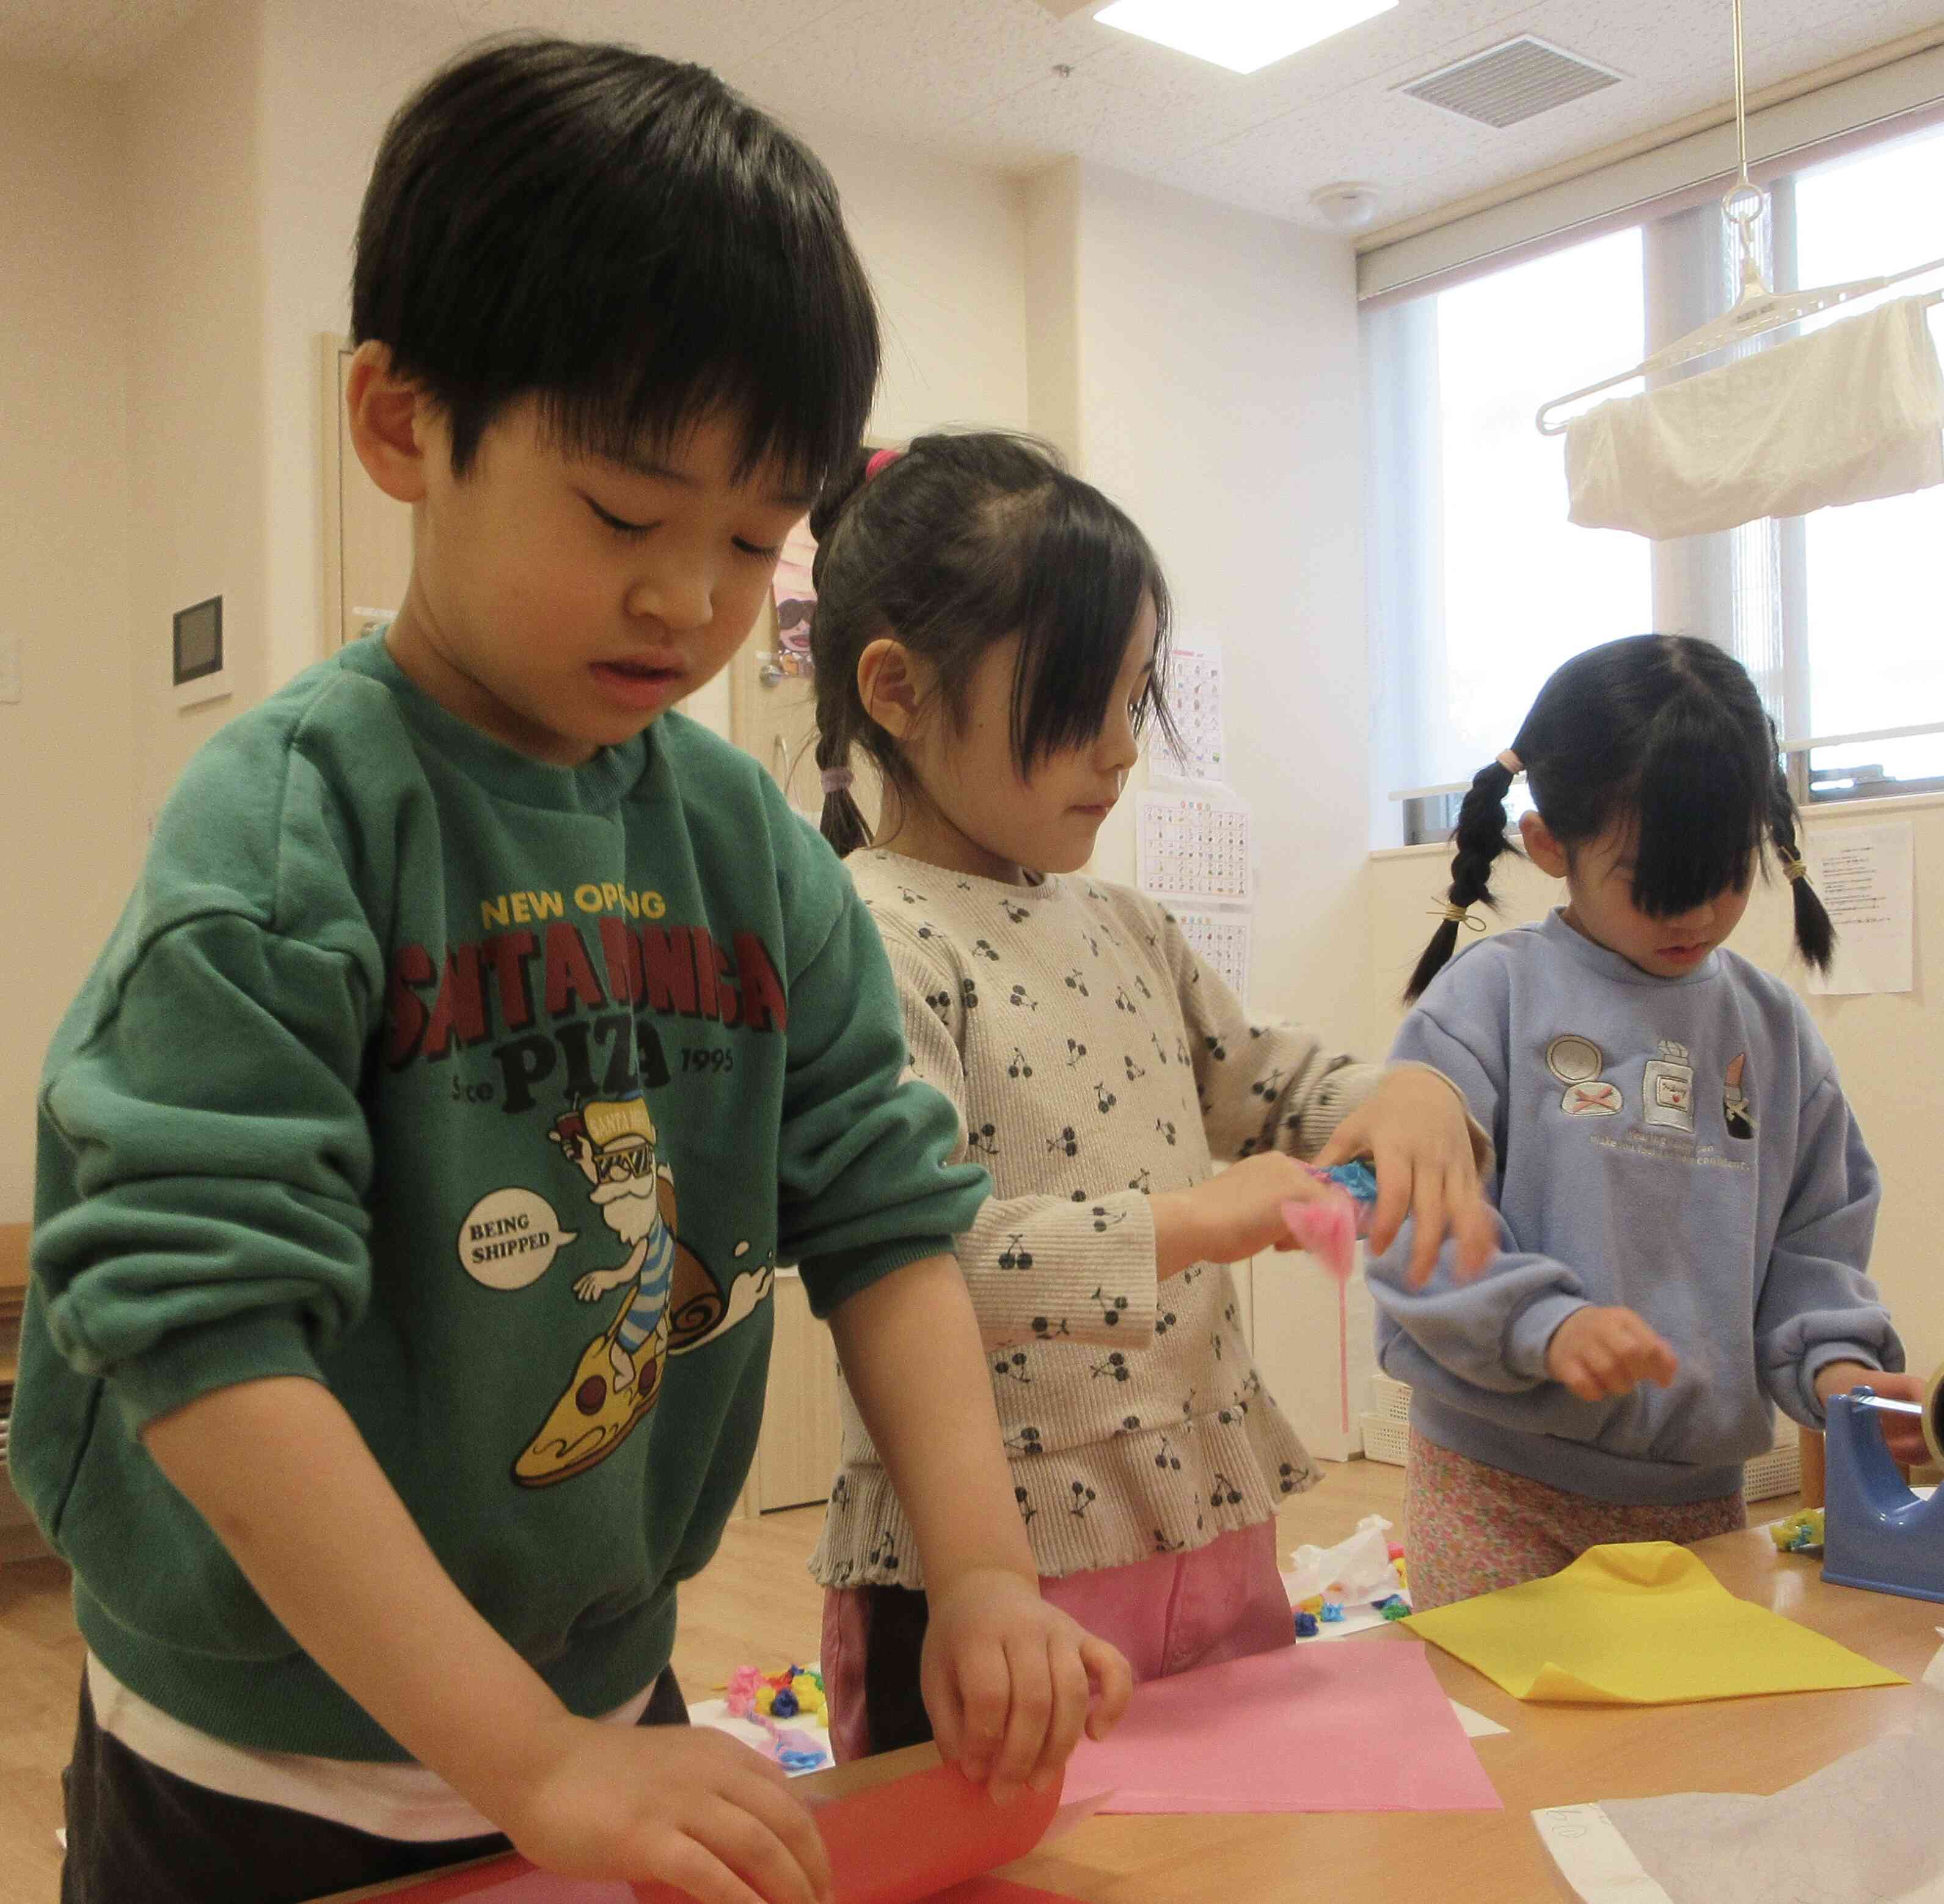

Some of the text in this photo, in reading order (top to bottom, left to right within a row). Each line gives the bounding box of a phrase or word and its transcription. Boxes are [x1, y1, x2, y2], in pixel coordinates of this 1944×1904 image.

[481, 890, 564, 929] NEW
[469, 1213, 530, 1242] BEING
[471, 1231, 550, 1264] SHIPPED
